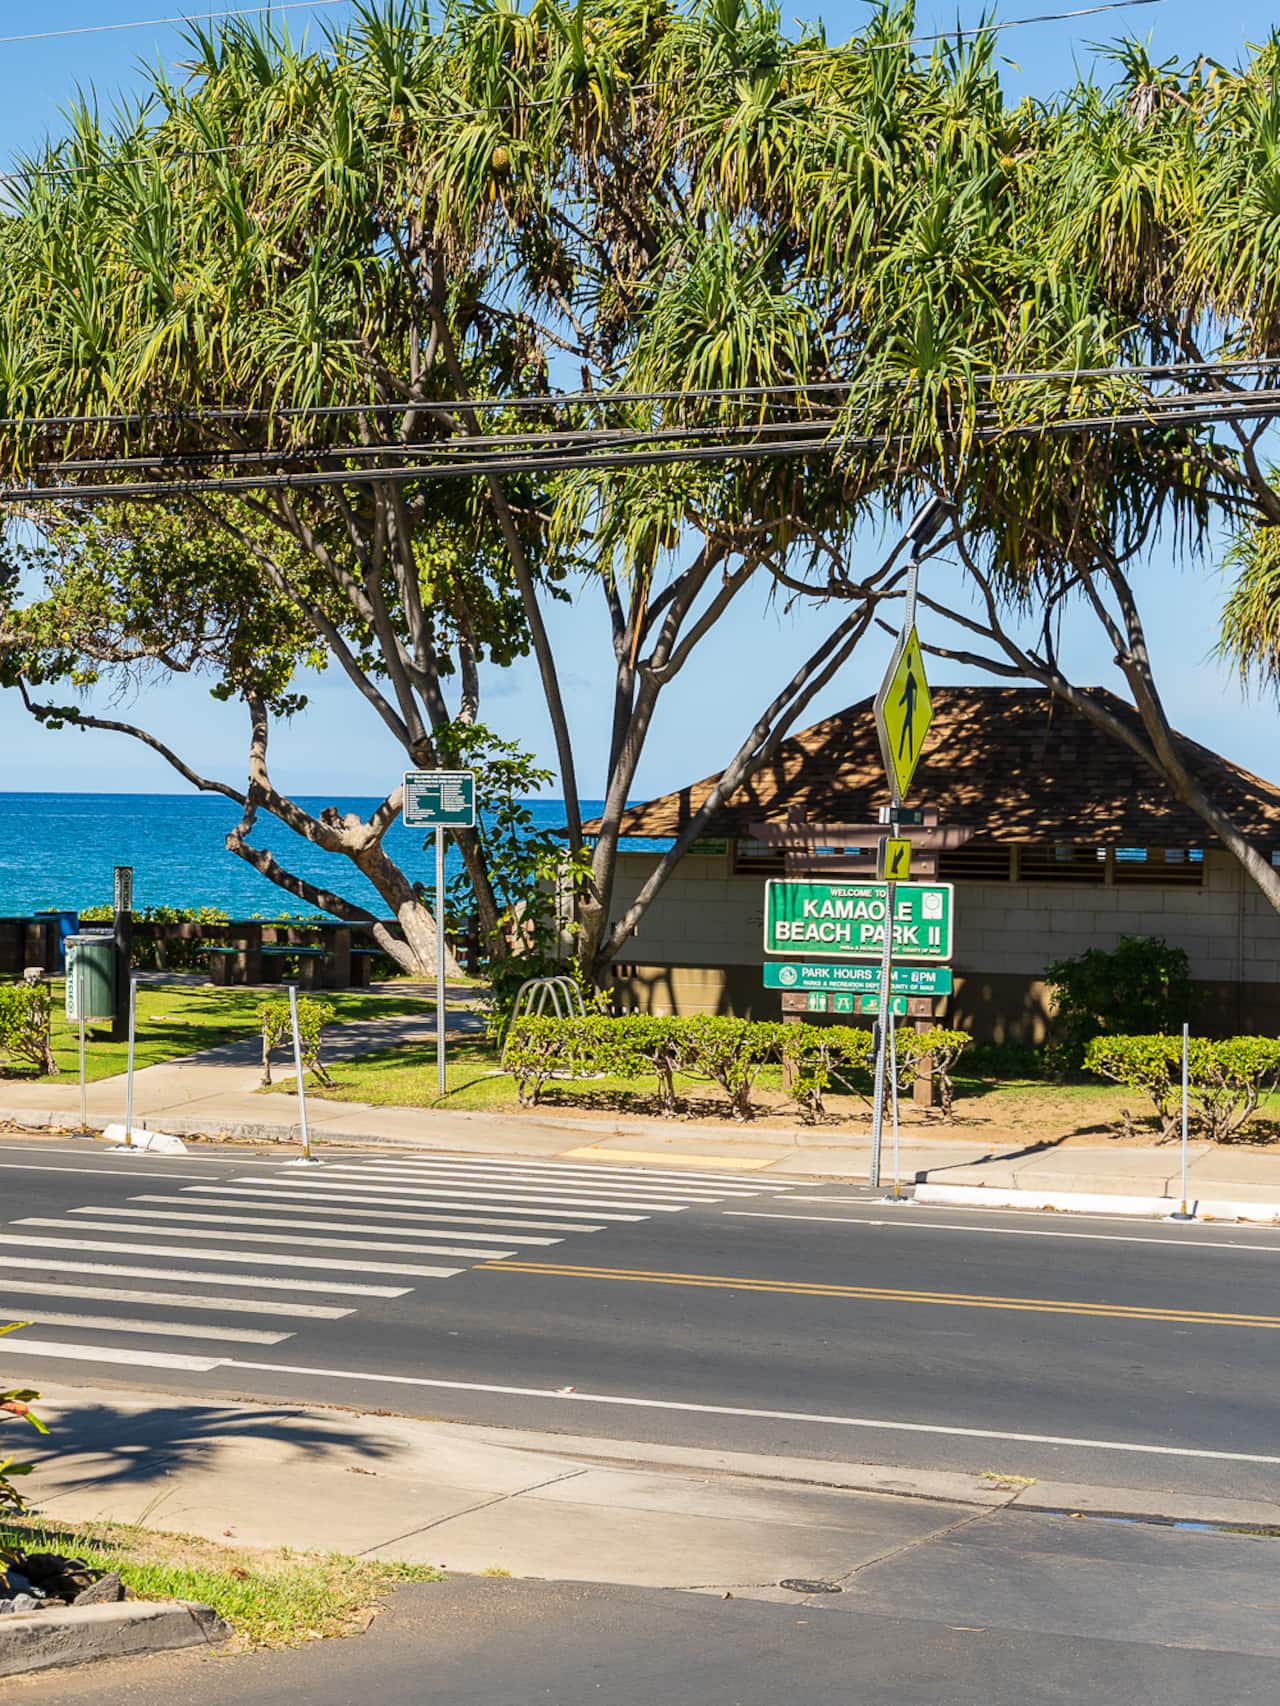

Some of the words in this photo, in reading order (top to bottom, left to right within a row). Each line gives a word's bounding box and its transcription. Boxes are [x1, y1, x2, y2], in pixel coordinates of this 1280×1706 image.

[830, 888, 872, 898] WELCOME
[874, 889, 887, 899] TO
[803, 899, 913, 922] KAMAOE
[775, 920, 851, 943] BEACH
[860, 923, 919, 945] PARK
[928, 926, 941, 946] II
[802, 967, 830, 978] PARK
[834, 968, 873, 980] HOURS
[875, 970, 899, 981] 7M
